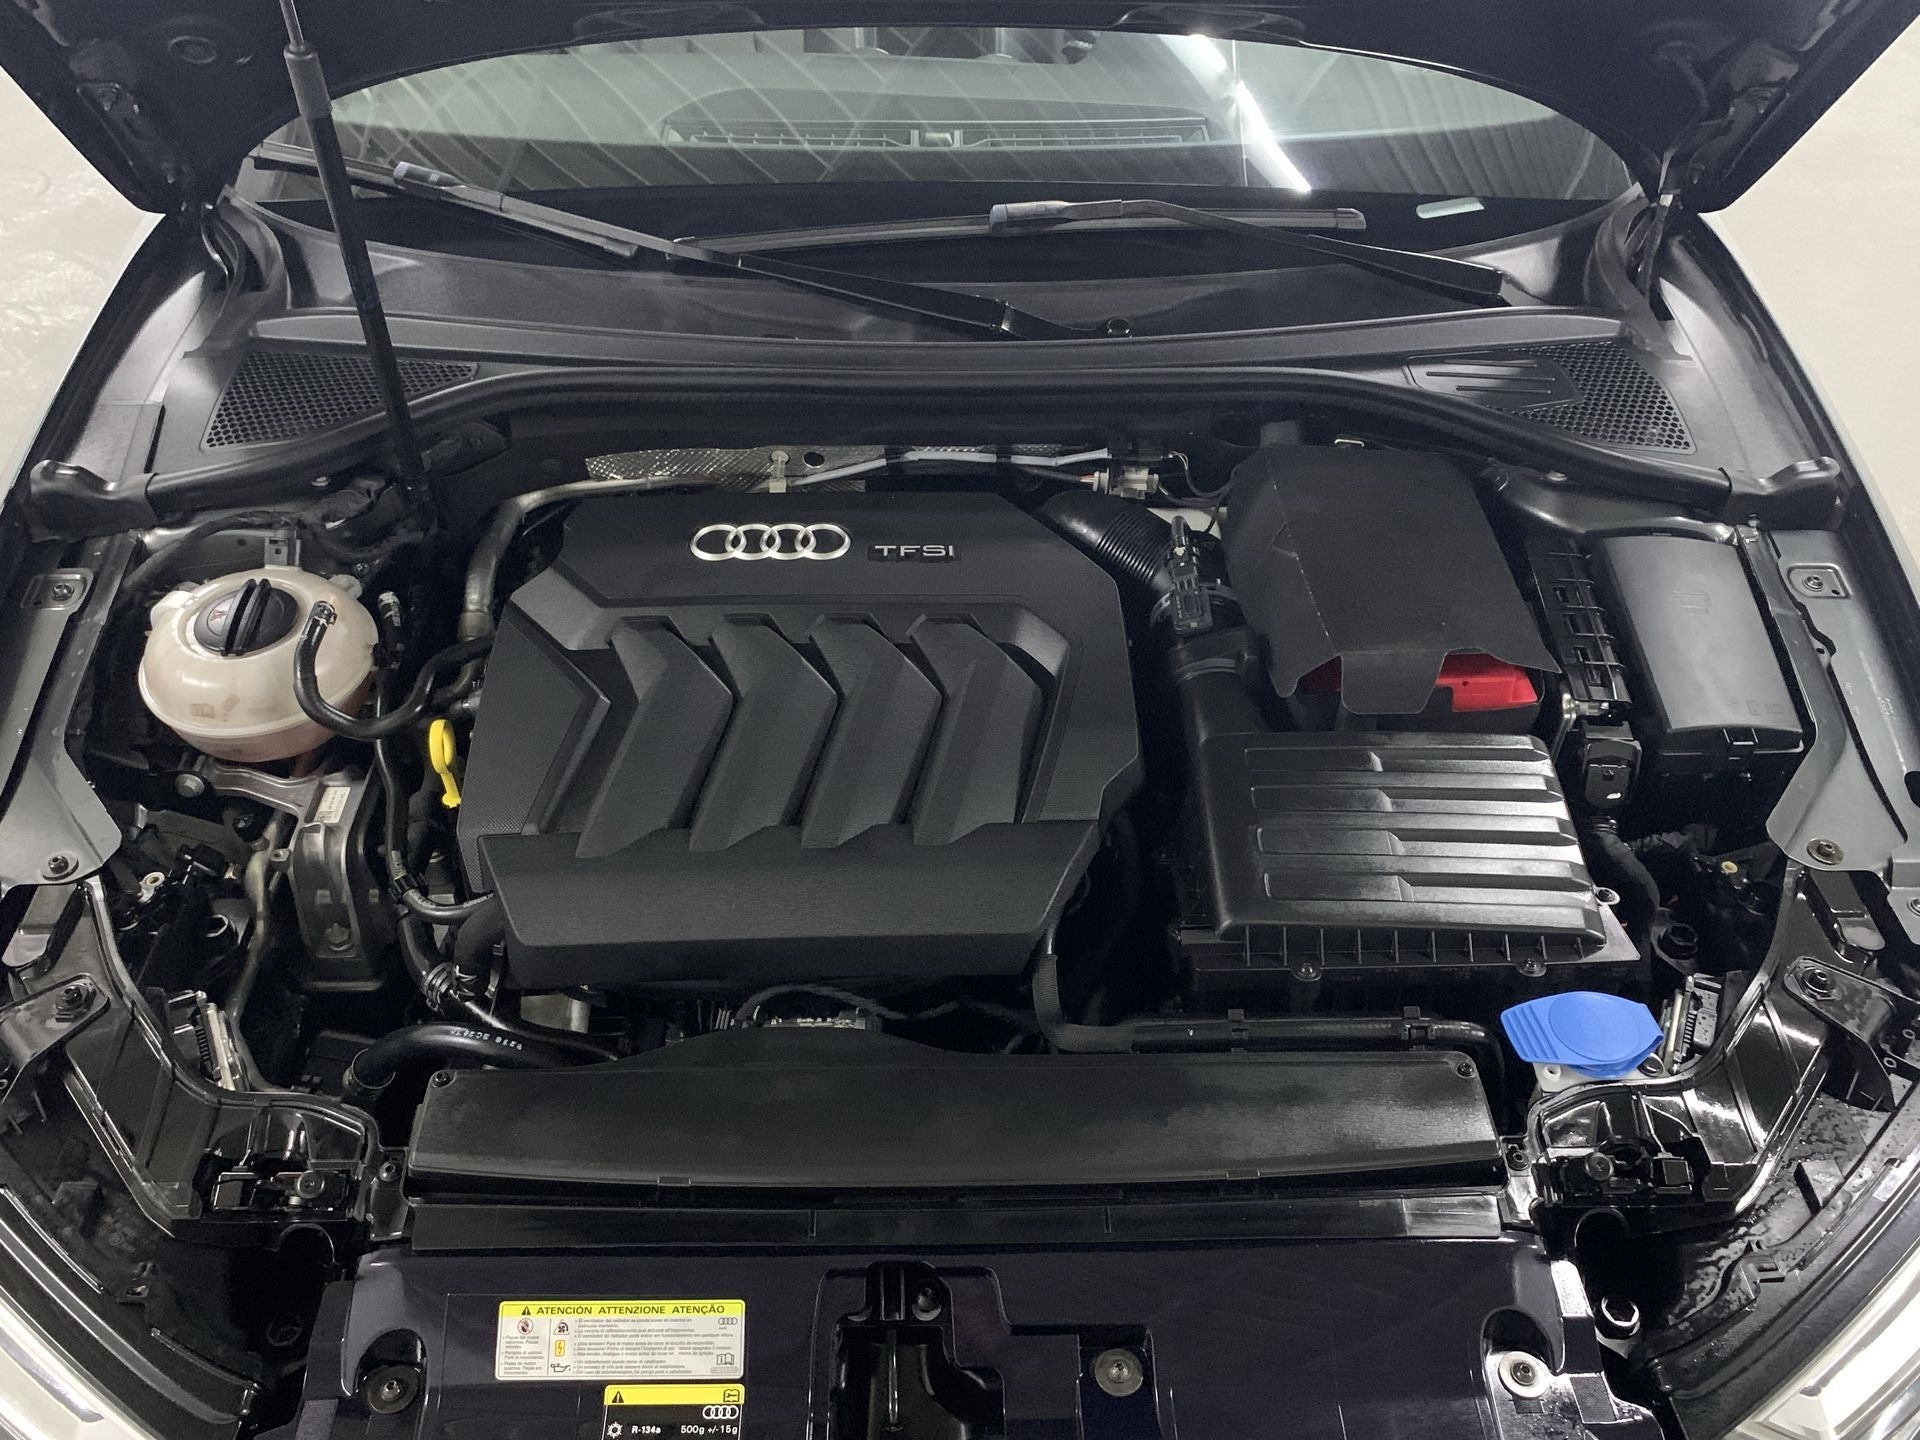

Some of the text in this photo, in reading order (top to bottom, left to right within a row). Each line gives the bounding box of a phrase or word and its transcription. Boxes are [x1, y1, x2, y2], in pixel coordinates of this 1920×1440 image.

[874, 545, 954, 557] TFSI
[536, 1303, 725, 1316] ATENCIÓN ATTENZIONE ATENÇÃO
[631, 1425, 661, 1434] R-134a
[680, 1425, 705, 1435] 500g
